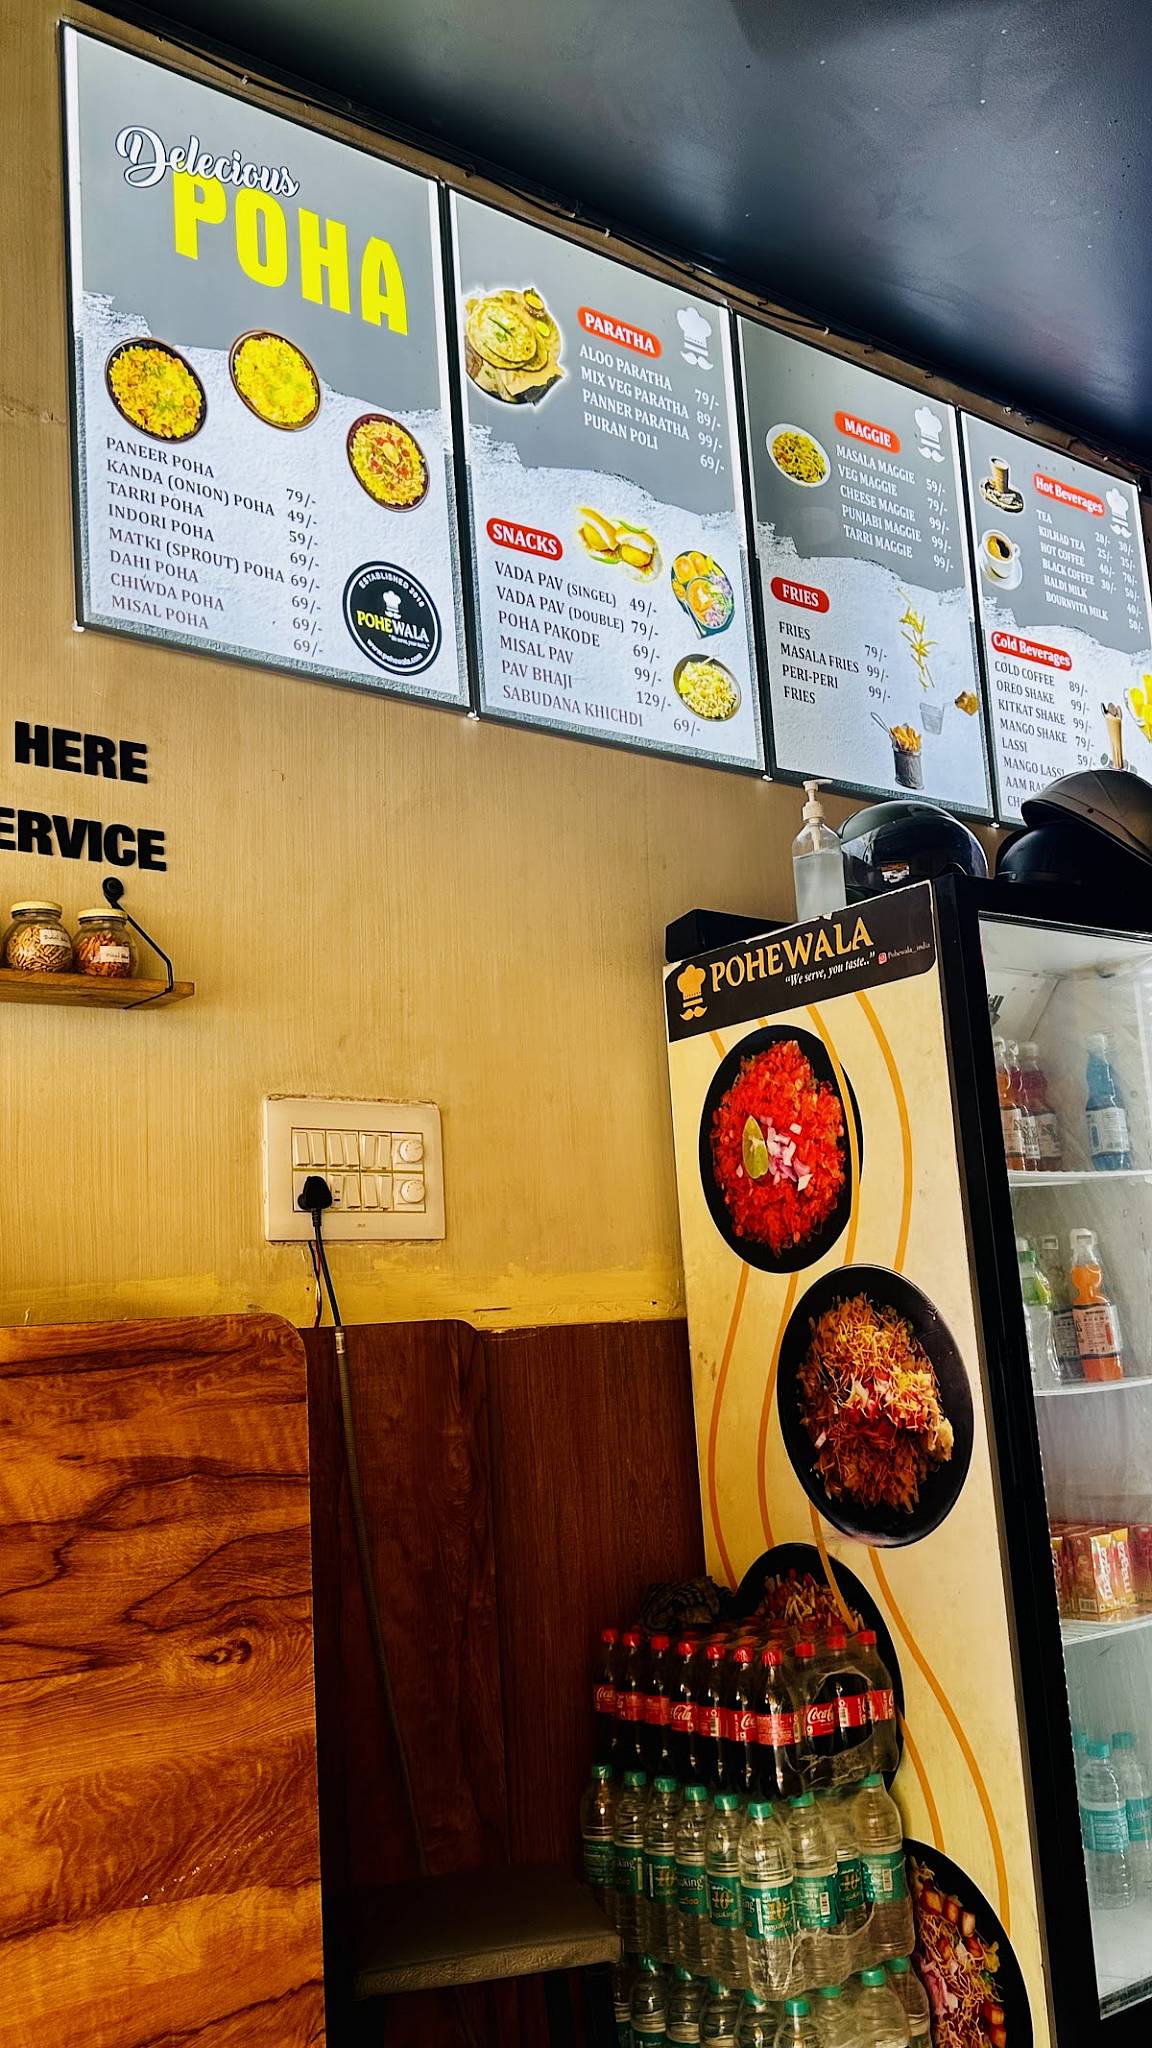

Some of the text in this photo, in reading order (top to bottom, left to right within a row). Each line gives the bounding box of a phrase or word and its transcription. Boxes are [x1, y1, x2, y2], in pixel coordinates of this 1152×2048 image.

[115, 126, 300, 197] Delecious
[172, 161, 408, 336] POHA
[584, 312, 655, 353] PARATHA
[580, 344, 719, 410] ALOO PARATHA 79/-
[581, 367, 721, 431] MIX VEG PARATHA 89/-
[583, 389, 723, 453] PANNER PARATHA 99/-
[584, 412, 724, 474] PURAN POLI 69/-
[844, 418, 892, 448] MAGGIE
[106, 437, 316, 507] PANEER POHA 79/-
[108, 459, 317, 528] KANDA (ONION) POHA 49/-
[836, 445, 946, 497] MASALA MAGGIE 59/-
[838, 464, 948, 516] VEG MAGGIE 79/-
[1035, 476, 1103, 513] Hot Beverages
[108, 481, 318, 550] TARRI POHA 59/-
[840, 485, 949, 535] CHEESE MAGGIE 99/-
[842, 504, 951, 553] PUNJABI MAGGIE 99/-
[1036, 509, 1052, 524] TEA
[109, 504, 319, 571] INDORI POHA 69/-
[109, 527, 320, 593] MATKI (SPROUT) POHA 69/-
[493, 523, 557, 555] SNACKS
[844, 525, 954, 572] TARRI MAGGIE 99/-
[1040, 542, 1056, 554] HOT
[1058, 549, 1085, 566] COFFEE
[1070, 537, 1086, 552] TEA
[110, 550, 321, 614] DAHI POHA 69/-
[359, 571, 409, 589] ESTABLISHED
[495, 561, 657, 617] VADA PAV (SINGEL) 49/-
[783, 583, 819, 607] FRIES
[1043, 558, 1066, 576] BLACK
[1068, 568, 1095, 585] COFFEE
[1044, 575, 1067, 591] HALDI
[1068, 584, 1088, 599] MILK
[111, 573, 322, 635] CHIWDA POHA 69/-
[112, 595, 323, 657] MISAL POHA 69/-
[356, 610, 429, 642] POHEWALA
[497, 586, 659, 640] VADA PAV (DOUBLE) 79/-
[1046, 591, 1088, 615] BOURNVITA
[1090, 607, 1108, 621] MILK
[499, 610, 660, 661] POHA PAKODE 69/-
[779, 621, 887, 662] FRIES 79/-
[993, 633, 1070, 667] Cold Beverages
[500, 635, 661, 687] MISAL PAV 99/-
[780, 642, 888, 682] MASALA FRIES 99/-
[782, 664, 890, 703] PERI-PERI 99/-
[995, 661, 1088, 696] COLD COFFEE 89/-
[502, 660, 671, 712] PAV BHAJI 129/-
[784, 686, 815, 704] FRIES
[997, 680, 1090, 715] OREO SHAKE 99/-
[503, 685, 701, 736] SABUDANA KHICHDI 69/-
[998, 699, 1092, 733] KITKAT SHAKE 99/-
[15, 721, 148, 784] HERE
[1000, 718, 1095, 751] MANGO SHAKE 79/-
[1002, 738, 1027, 752] LASSI
[1004, 756, 1065, 777] MANGO LASSI
[1006, 776, 1027, 792] AAM
[710, 917, 874, 993] POHEWALA
[805, 968, 826, 982] serve,
[828, 962, 843, 978] you
